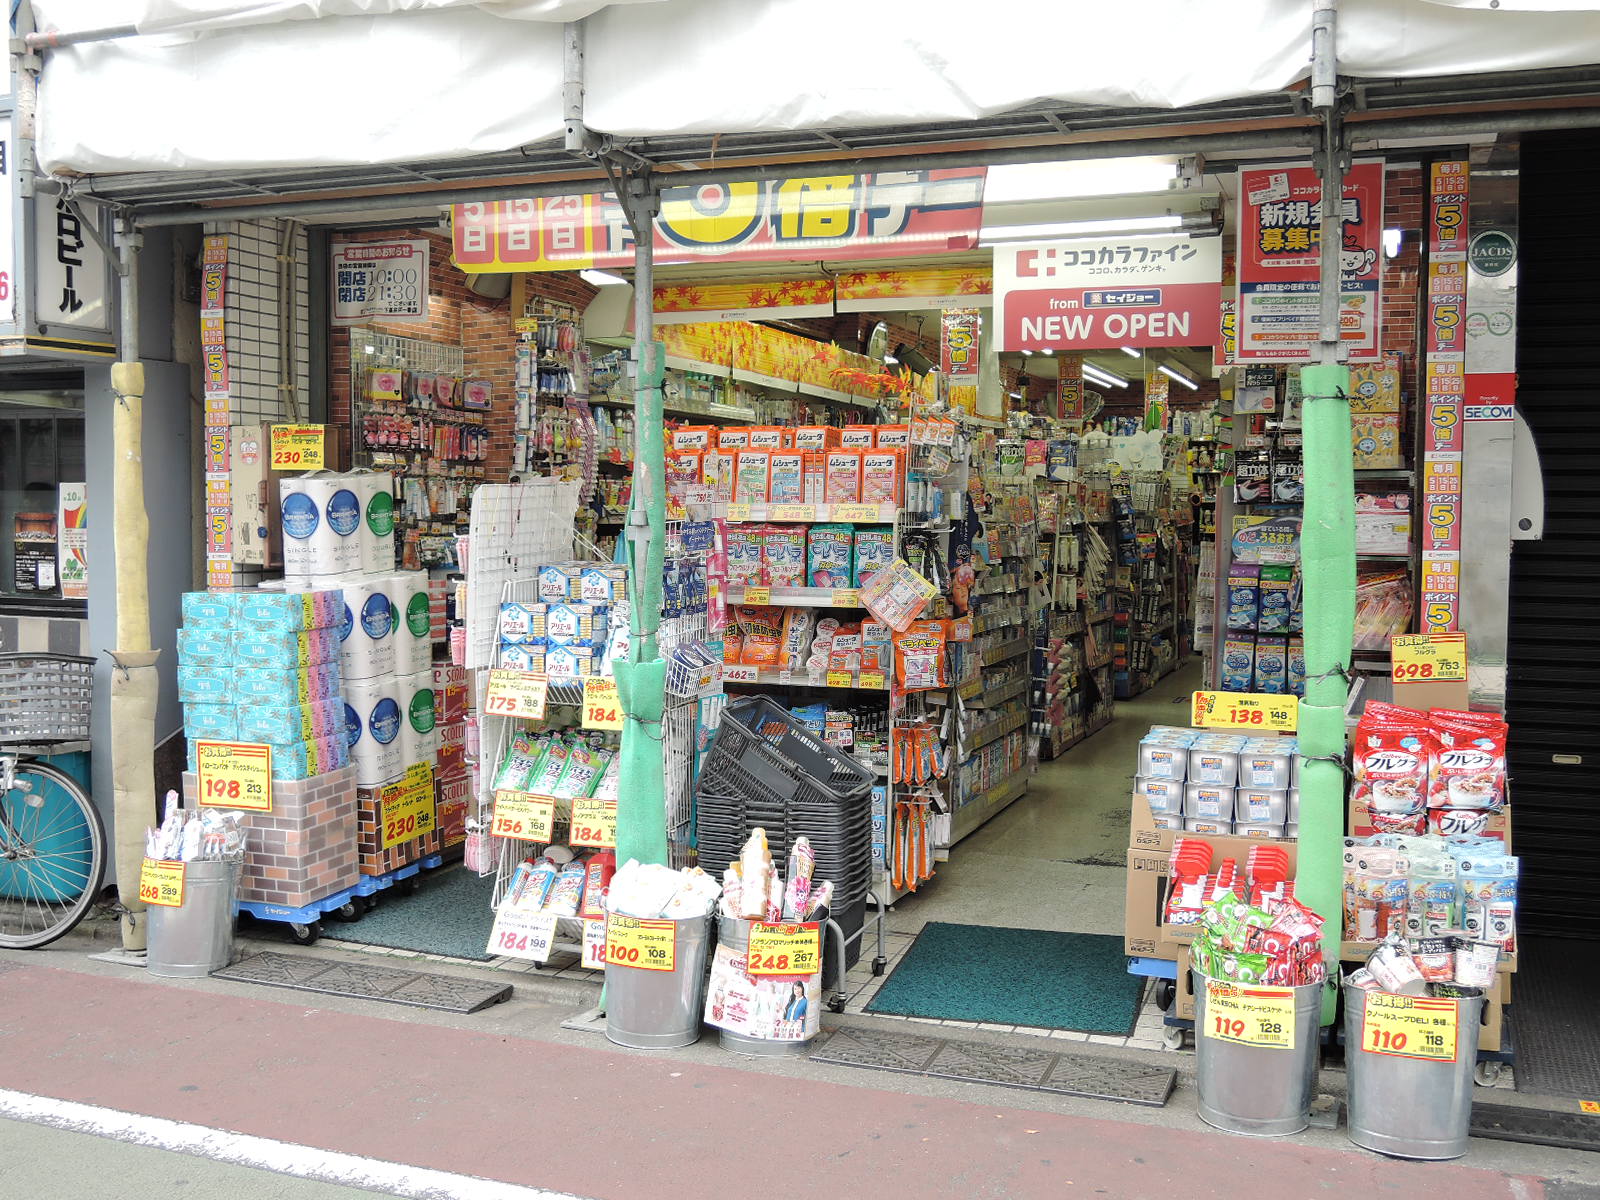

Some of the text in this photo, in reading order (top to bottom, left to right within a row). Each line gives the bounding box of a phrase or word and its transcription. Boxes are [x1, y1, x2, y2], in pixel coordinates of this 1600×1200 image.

[1440, 163, 1462, 174] 毎月
[1433, 194, 1467, 203] ポイント
[1064, 244, 1198, 267] ココカラファイン
[1472, 246, 1513, 257] JACDS
[1438, 264, 1459, 275] 毎月
[338, 268, 417, 286] 開店 10:00
[338, 285, 416, 303] 閉店 21:30
[1105, 292, 1154, 304] セイジョー
[1431, 295, 1464, 303] ポイント
[1050, 298, 1079, 310] from
[1021, 312, 1190, 341] NEW OPEN
[1435, 364, 1456, 374] 毎月
[1429, 395, 1462, 403] ポイント
[1465, 406, 1512, 418] SECOM
[797, 433, 824, 441] ムシューダ
[274, 451, 300, 464] 230
[1236, 464, 1270, 477] 超立体
[1433, 463, 1454, 473] 毎月
[1427, 494, 1459, 503] ポイント
[1431, 562, 1452, 572] 毎月
[542, 584, 562, 592] アリエール
[583, 587, 605, 595] アリエール
[1424, 593, 1456, 601] ポイント
[503, 621, 525, 629] アリエール
[550, 622, 572, 631] アリエール
[900, 639, 940, 649] ドライペット
[503, 662, 524, 670] アリエール
[549, 664, 570, 672] アリエール
[1394, 662, 1460, 678] 698 753
[728, 670, 748, 679] 462
[490, 697, 517, 711] 175
[588, 707, 616, 721] 184
[1231, 709, 1287, 724] 138 148
[1367, 757, 1419, 770] フルグラ
[1441, 754, 1494, 766] フルグラ
[206, 779, 262, 799] 198 213
[386, 814, 415, 841] 230
[497, 818, 544, 833] 156 168
[1441, 814, 1489, 834] フルグ
[575, 827, 603, 841] 184
[140, 884, 158, 899] 268
[498, 931, 546, 951] 184 198
[609, 944, 666, 962] 100 108
[750, 953, 814, 970] 248 267
[1367, 1010, 1429, 1024] クノールスープDELI
[1215, 1016, 1282, 1037] 119 128
[1372, 1029, 1443, 1050] 110 118
